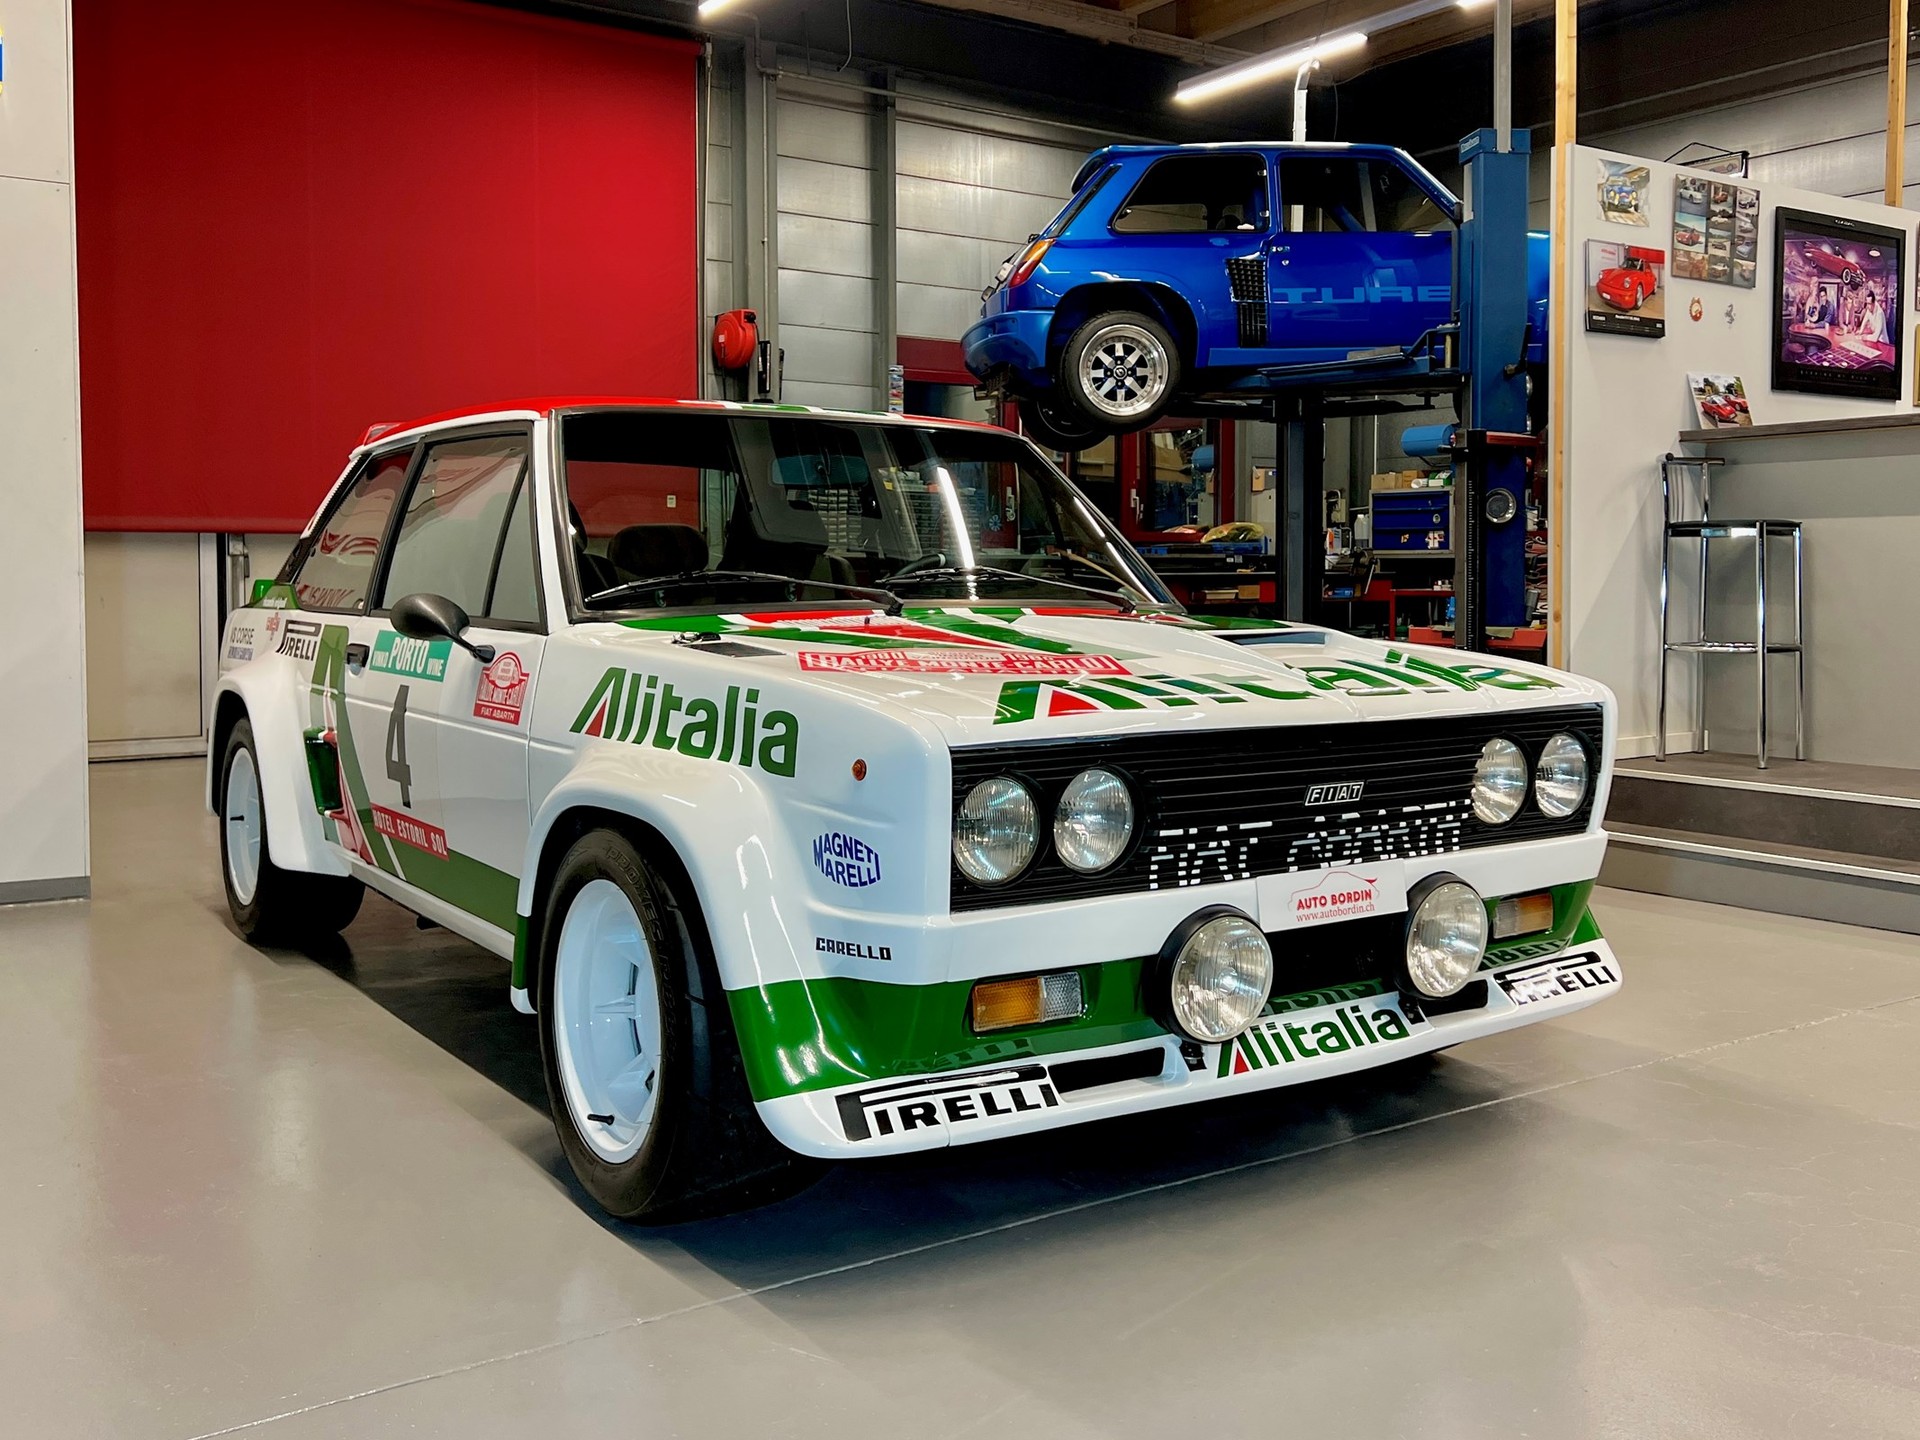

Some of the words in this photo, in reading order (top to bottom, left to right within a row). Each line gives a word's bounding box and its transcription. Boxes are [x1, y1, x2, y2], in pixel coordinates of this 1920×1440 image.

[275, 619, 322, 661] PIRELLI
[388, 637, 430, 674] PORTO
[819, 653, 909, 668] RALLYE
[917, 656, 1102, 671] MONTE-CARLO
[993, 648, 1565, 725] Alitalia
[569, 667, 799, 778] Alitalia
[385, 684, 412, 809] 4
[1310, 786, 1361, 802] FIAT
[372, 809, 395, 834] HOTEL
[397, 818, 428, 848] ESTORIL
[430, 832, 447, 856] SOL
[813, 832, 881, 868] MAGNETI
[813, 850, 881, 887] MARELLI
[1150, 820, 1273, 890] FIAT
[1296, 895, 1327, 911] AUTO
[1331, 889, 1372, 906] BORDIN
[1296, 902, 1375, 922] www.autobordin.ch
[816, 937, 892, 960] CARELLO
[1217, 1005, 1411, 1079] Alitalia
[834, 1063, 1059, 1142] PIRELLI
